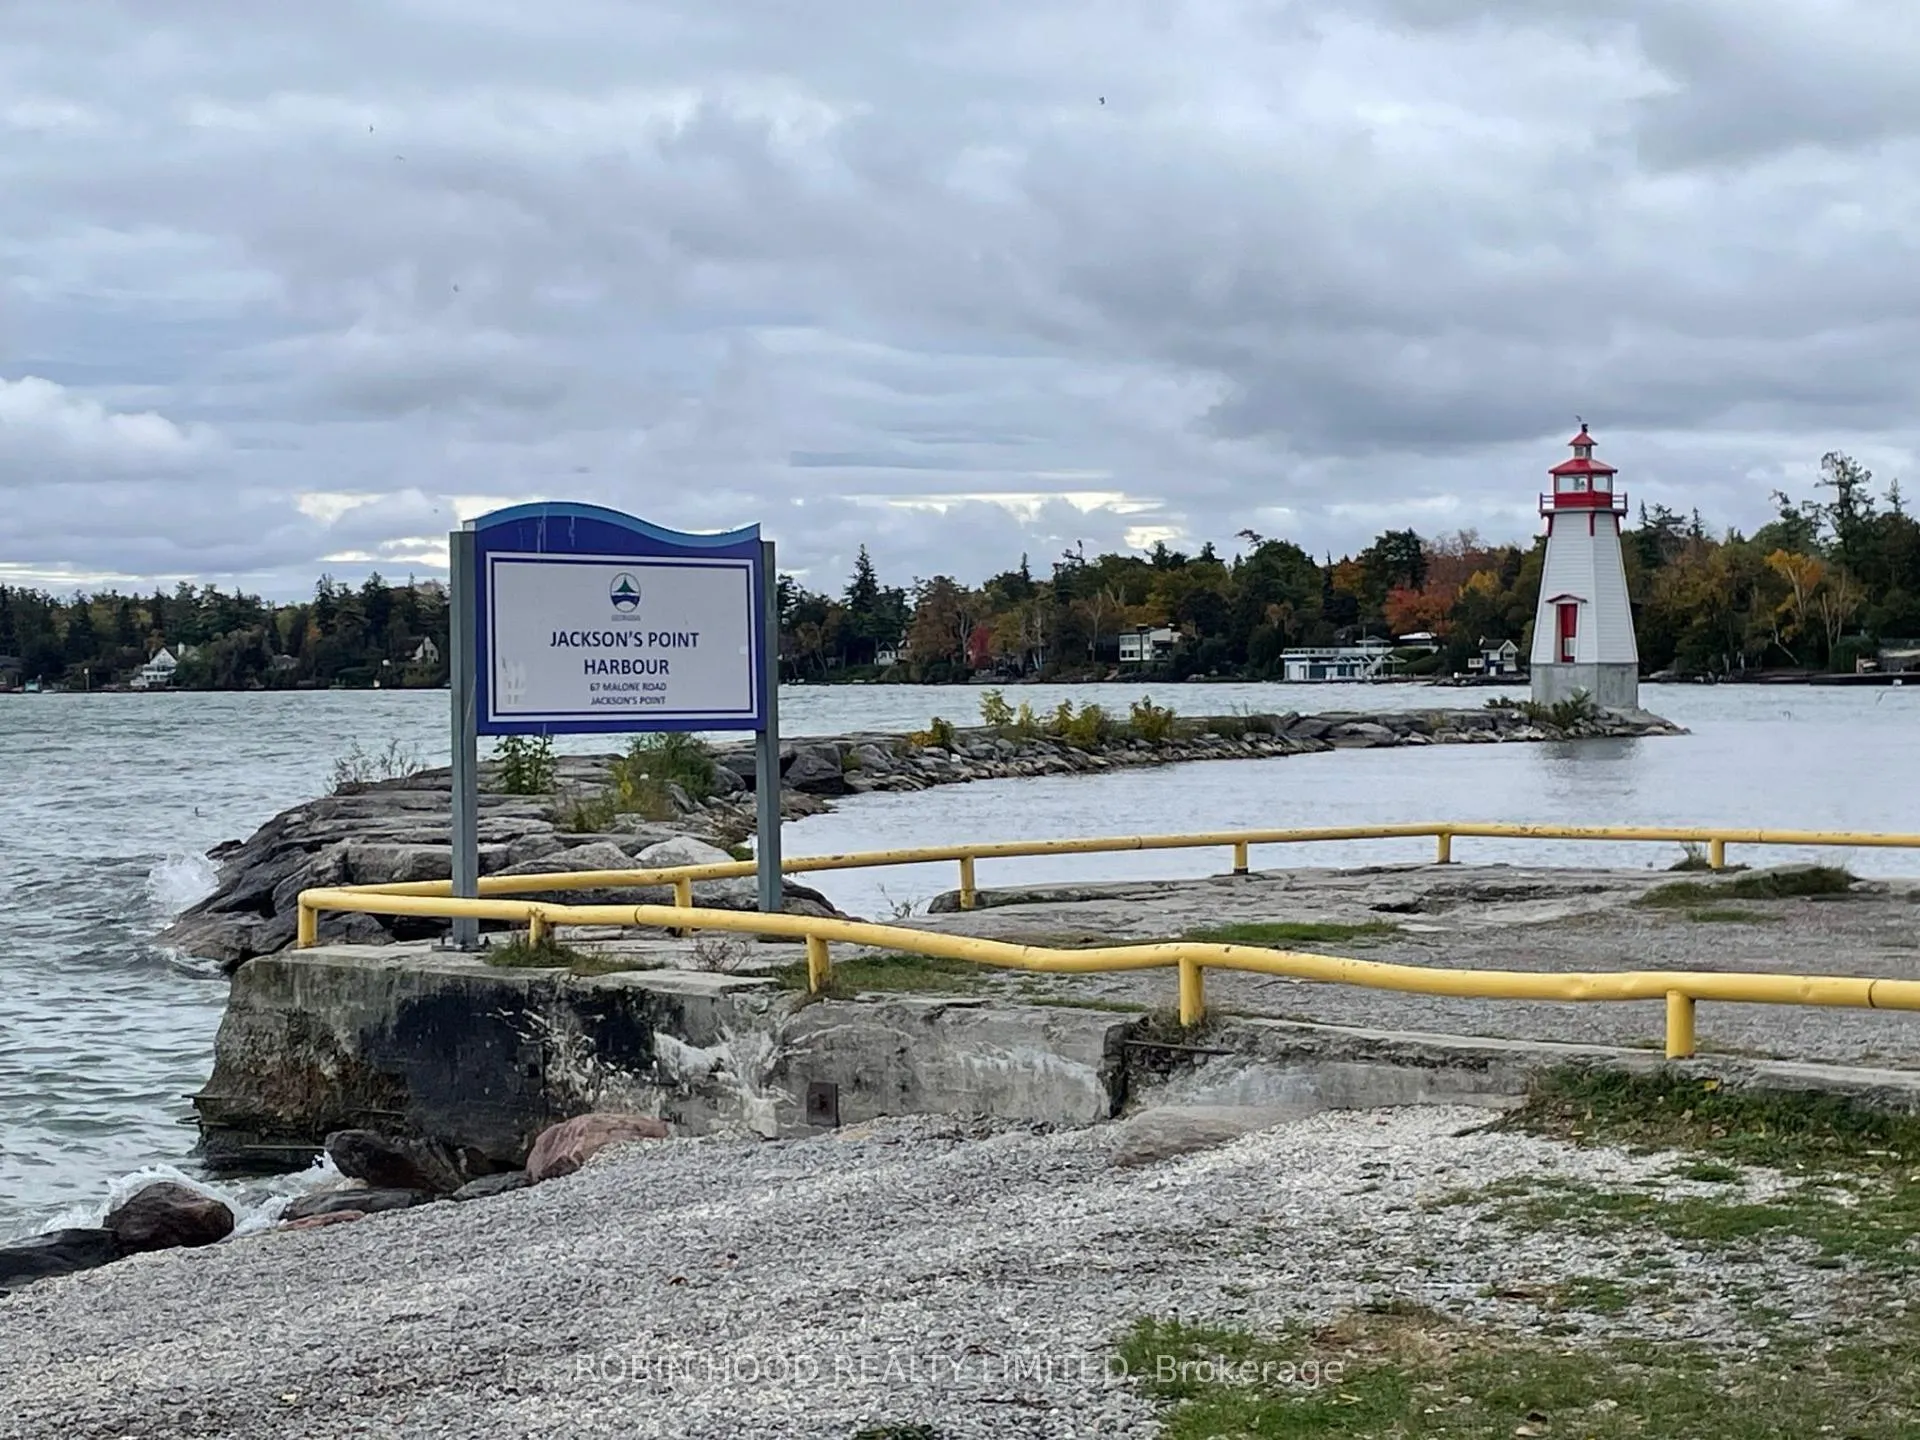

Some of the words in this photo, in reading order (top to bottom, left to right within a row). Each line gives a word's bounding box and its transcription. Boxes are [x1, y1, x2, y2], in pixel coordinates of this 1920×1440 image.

[550, 631, 643, 648] JACKSON'S
[648, 631, 700, 648] POINT
[584, 659, 670, 675] HARBOUR
[590, 682, 600, 691] 67
[602, 682, 640, 691] MALONE
[642, 682, 667, 691] ROAD
[591, 696, 638, 705] JACKSON'S
[640, 696, 666, 704] POINT
